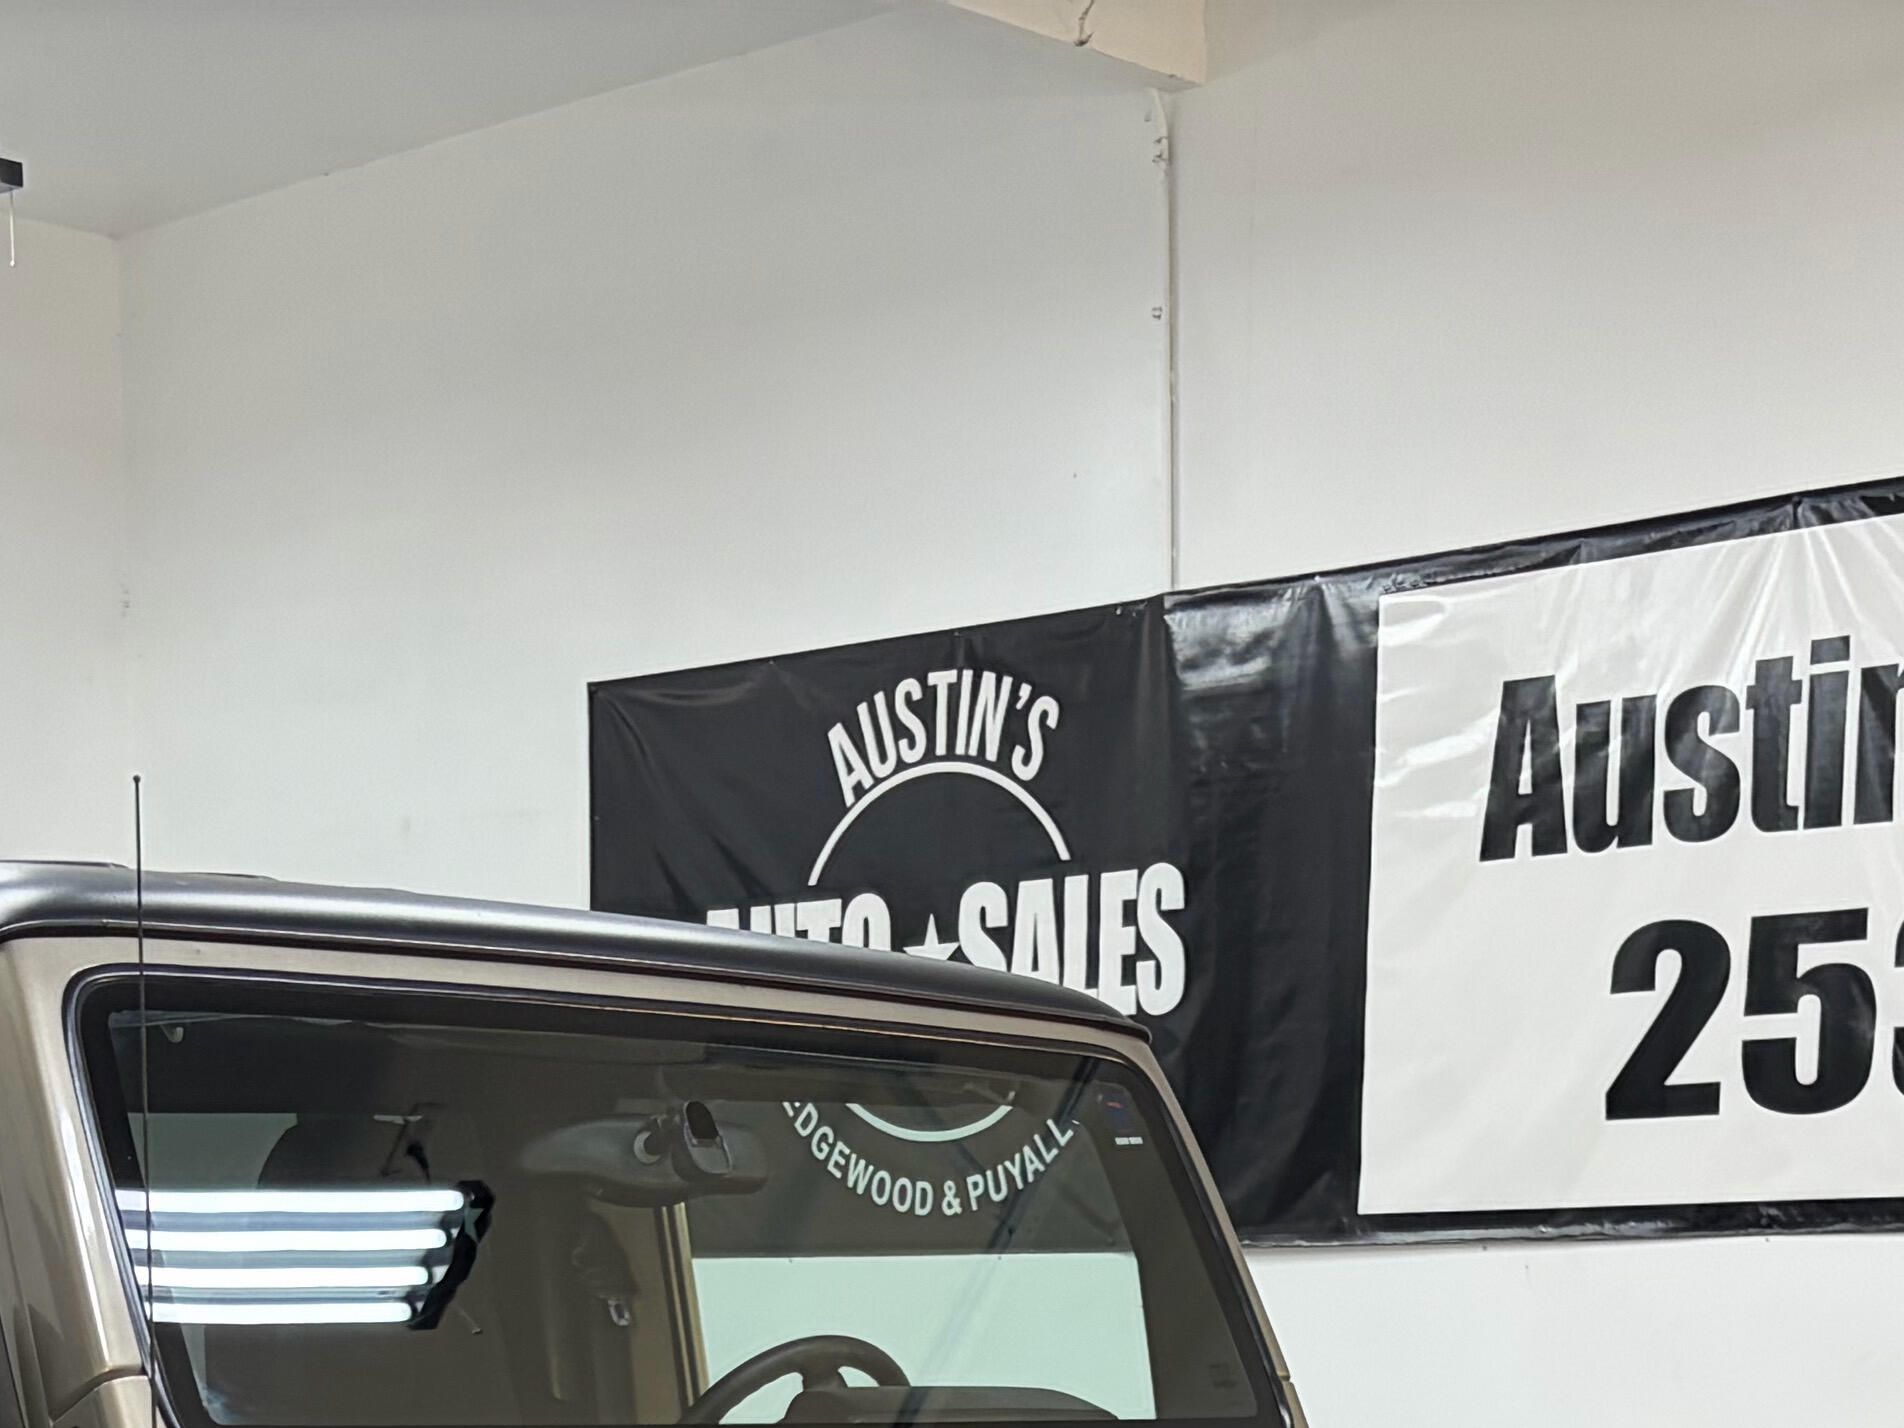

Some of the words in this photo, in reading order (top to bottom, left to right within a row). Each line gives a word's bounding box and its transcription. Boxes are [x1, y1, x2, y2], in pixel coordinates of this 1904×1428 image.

[827, 668, 1060, 808] AUSTIN'S
[957, 861, 1186, 1017] SALES
[942, 1179, 964, 1217] &
[965, 1118, 1080, 1212] PUYALL
